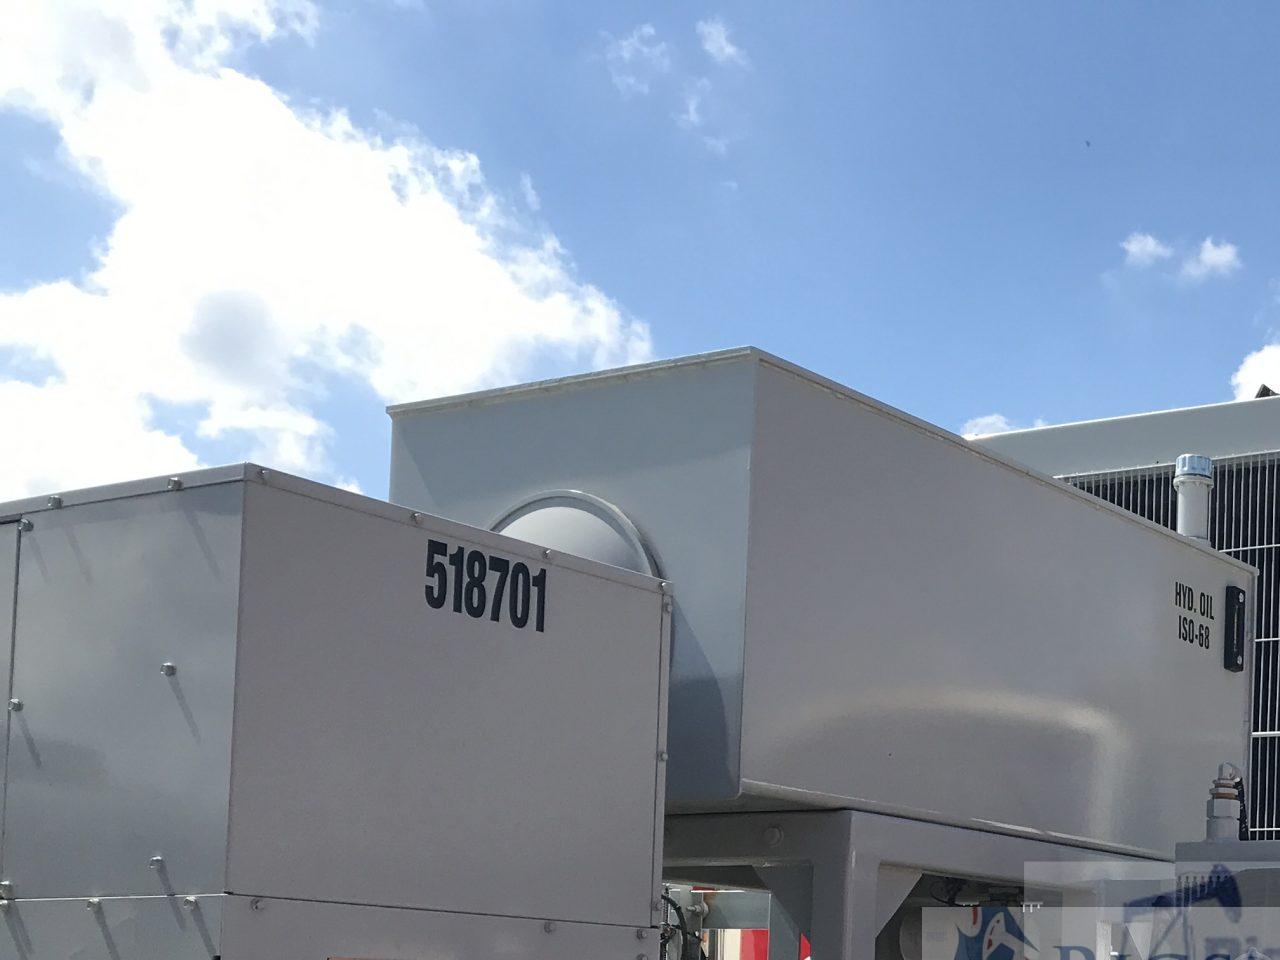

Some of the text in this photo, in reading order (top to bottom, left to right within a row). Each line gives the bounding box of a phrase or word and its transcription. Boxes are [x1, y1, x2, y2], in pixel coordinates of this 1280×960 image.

[425, 539, 546, 632] 518701
[1175, 581, 1214, 620] HYD. OIL
[1178, 615, 1210, 649] ISO-68
